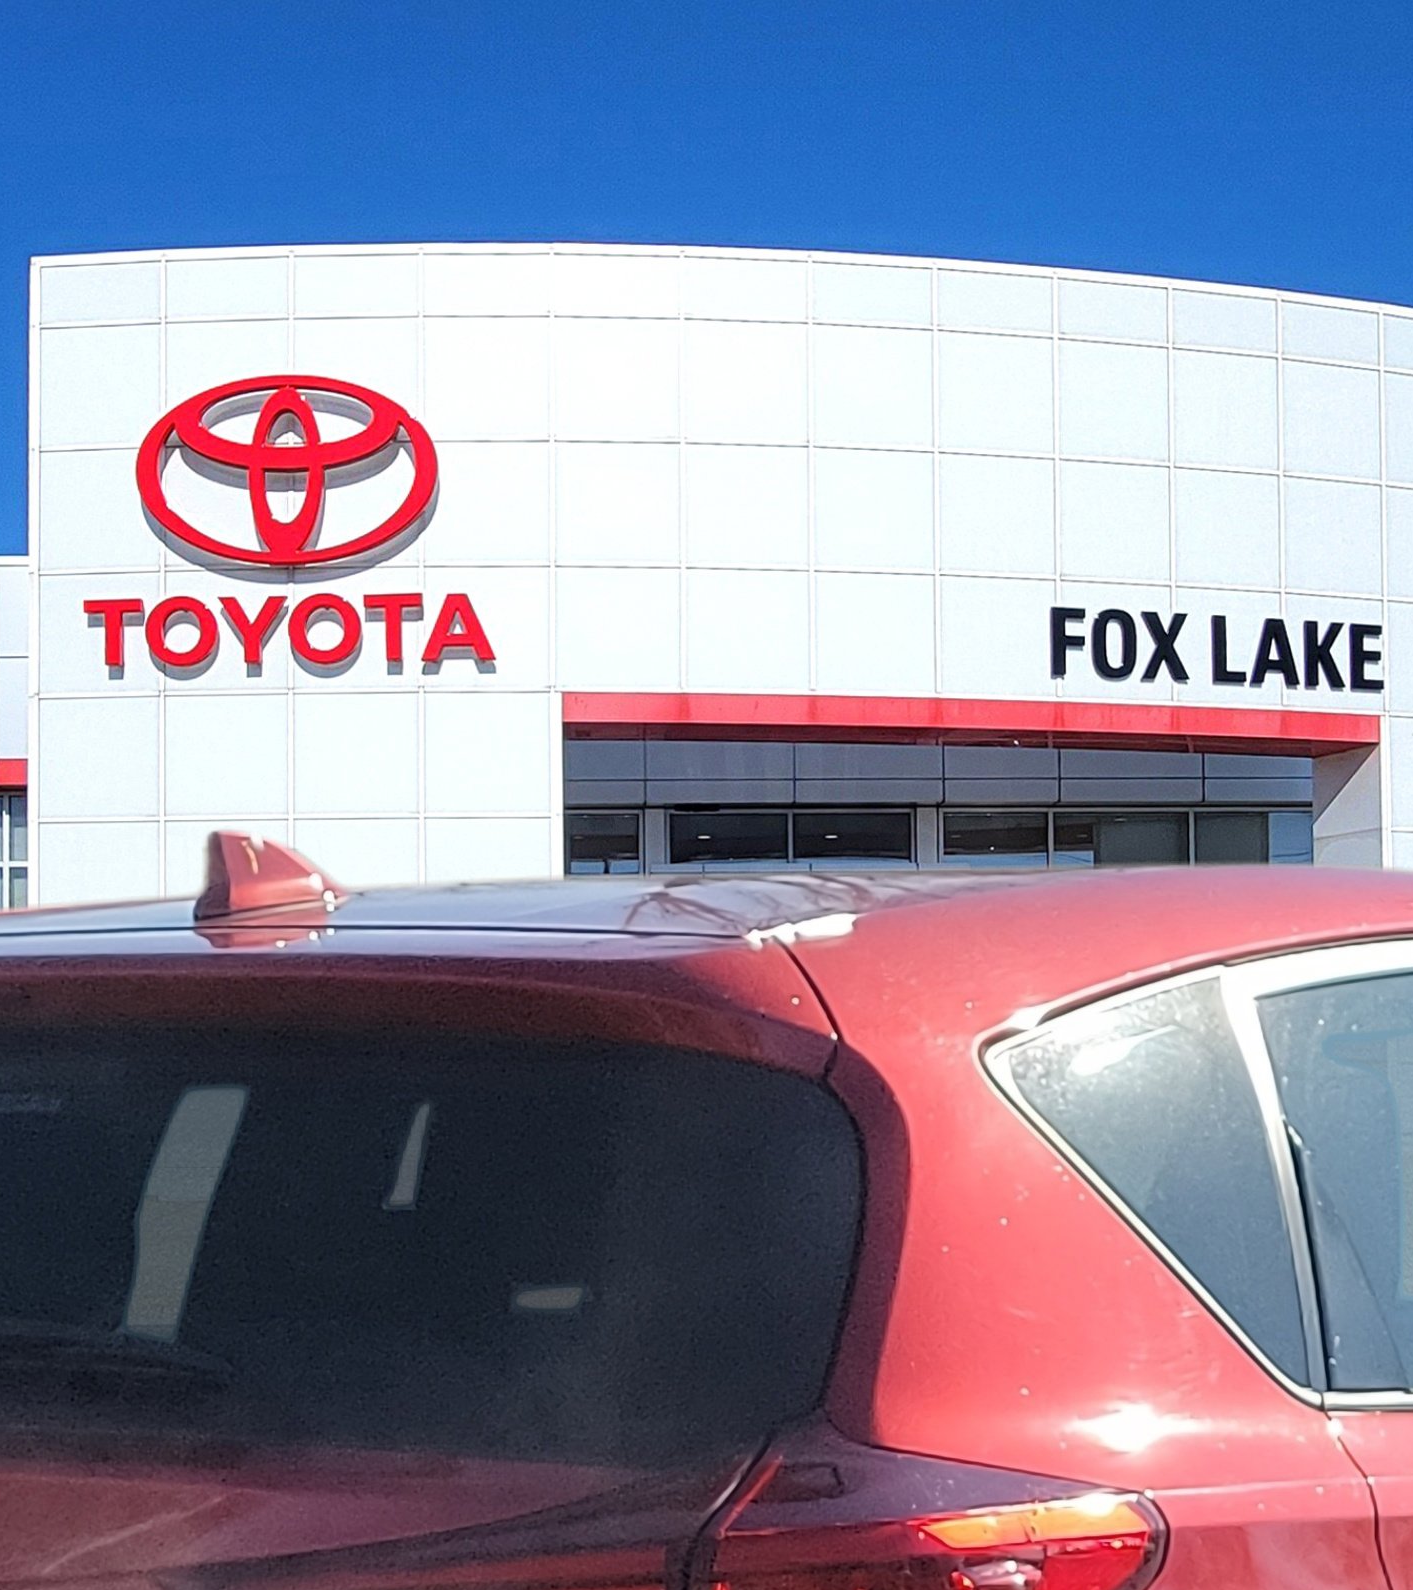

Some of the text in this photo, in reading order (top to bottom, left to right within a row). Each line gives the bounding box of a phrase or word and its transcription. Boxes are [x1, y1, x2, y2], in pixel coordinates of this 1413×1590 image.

[83, 593, 497, 672] TOYOTA
[1050, 606, 1385, 692] FOX LAKE
